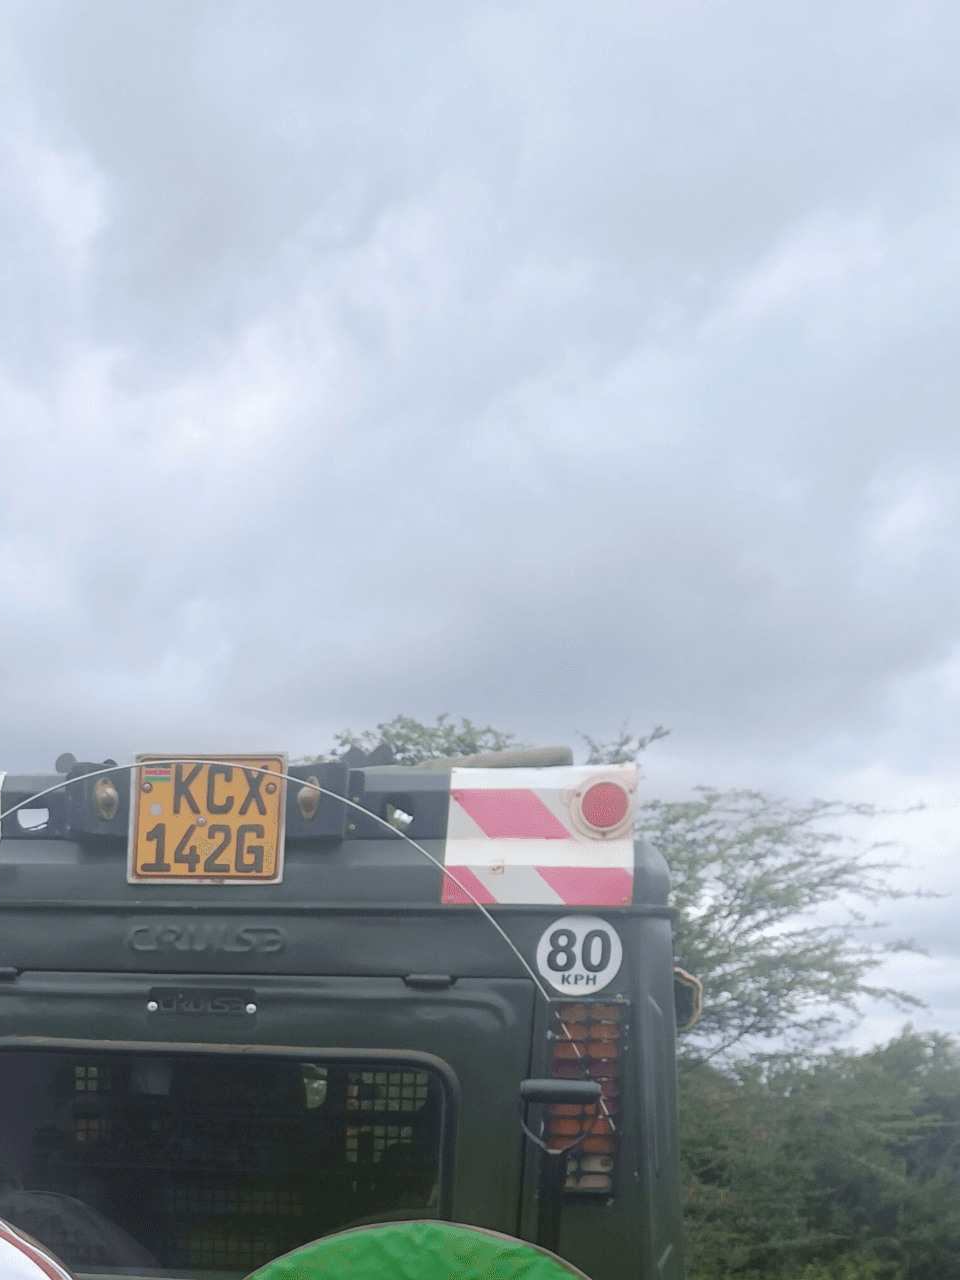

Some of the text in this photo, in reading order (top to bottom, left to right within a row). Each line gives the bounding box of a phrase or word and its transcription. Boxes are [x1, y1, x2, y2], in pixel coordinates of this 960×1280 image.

[173, 764, 268, 816] KCX
[141, 823, 266, 874] 142G
[547, 928, 612, 973] 80
[561, 973, 597, 986] KPH
